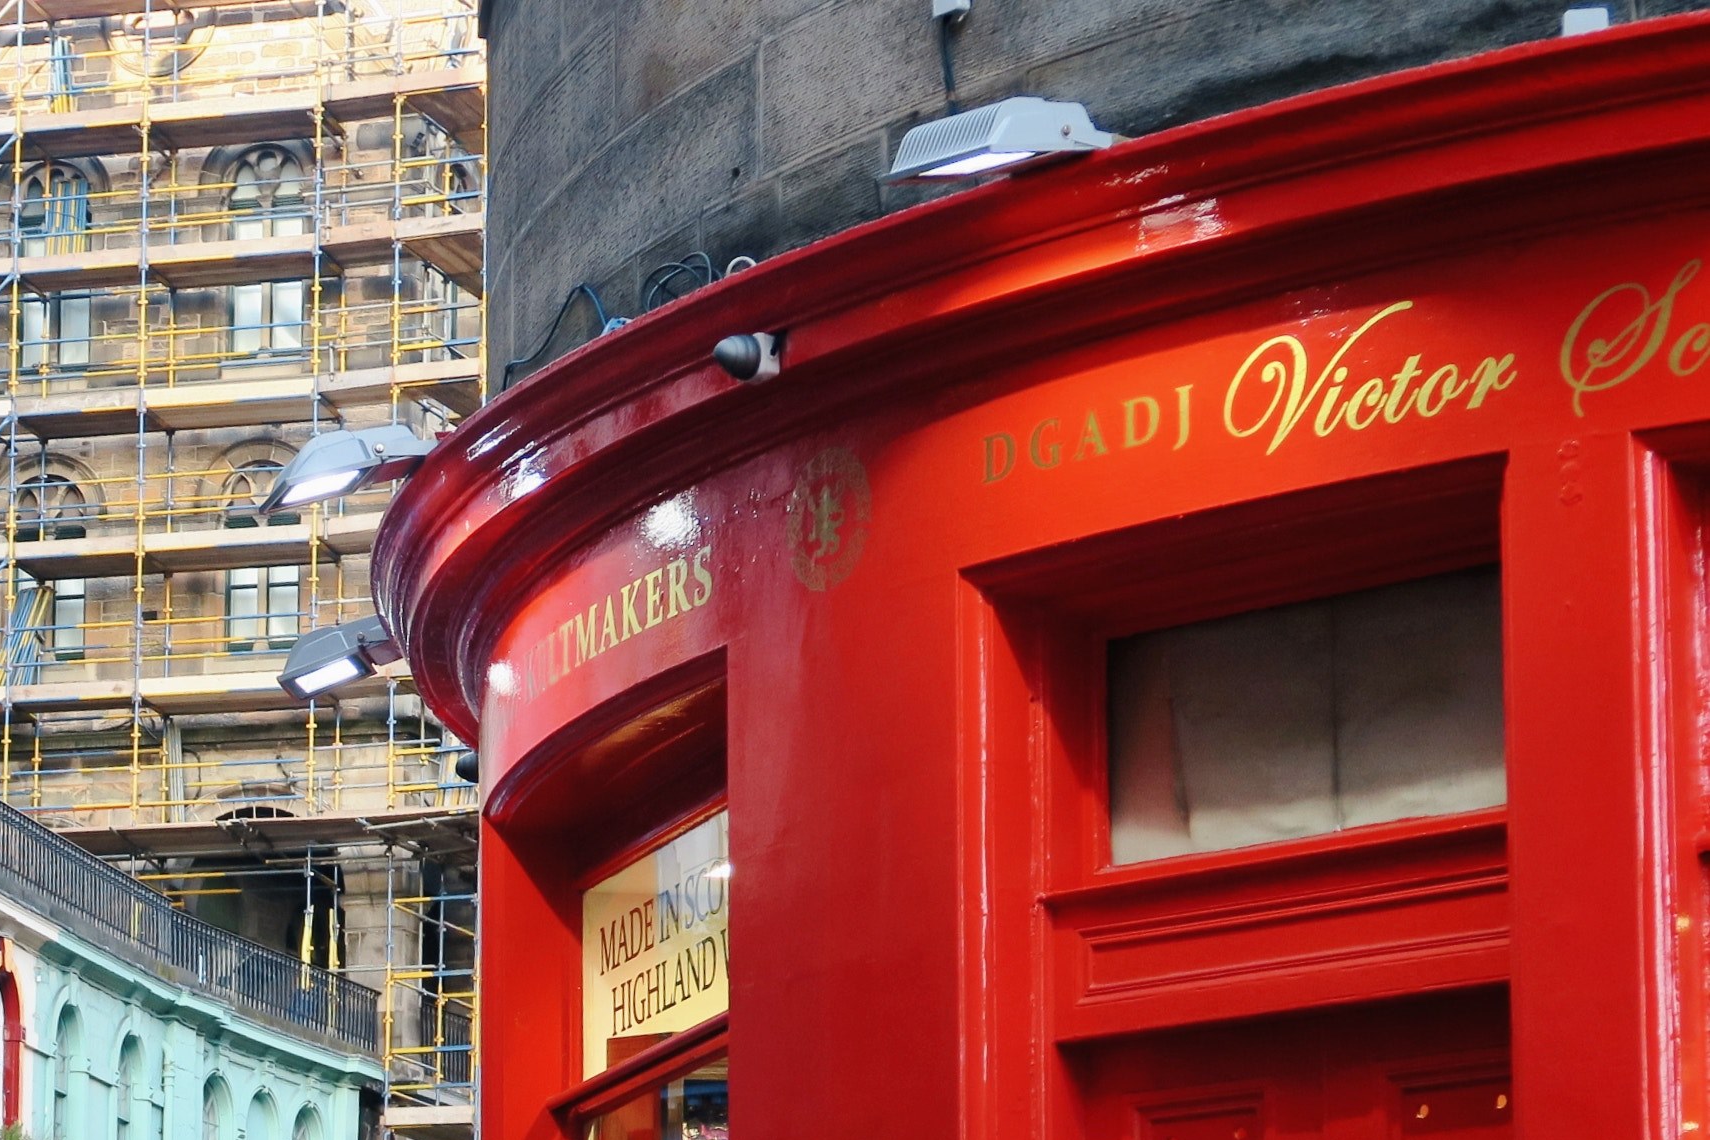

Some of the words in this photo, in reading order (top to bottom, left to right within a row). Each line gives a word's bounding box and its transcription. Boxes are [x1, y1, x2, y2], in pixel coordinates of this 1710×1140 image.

[1223, 300, 1518, 456] Victor
[599, 898, 655, 977] MADE
[659, 882, 681, 944] IN
[685, 860, 727, 930] SCO
[611, 935, 717, 1037] HIGHLAND
